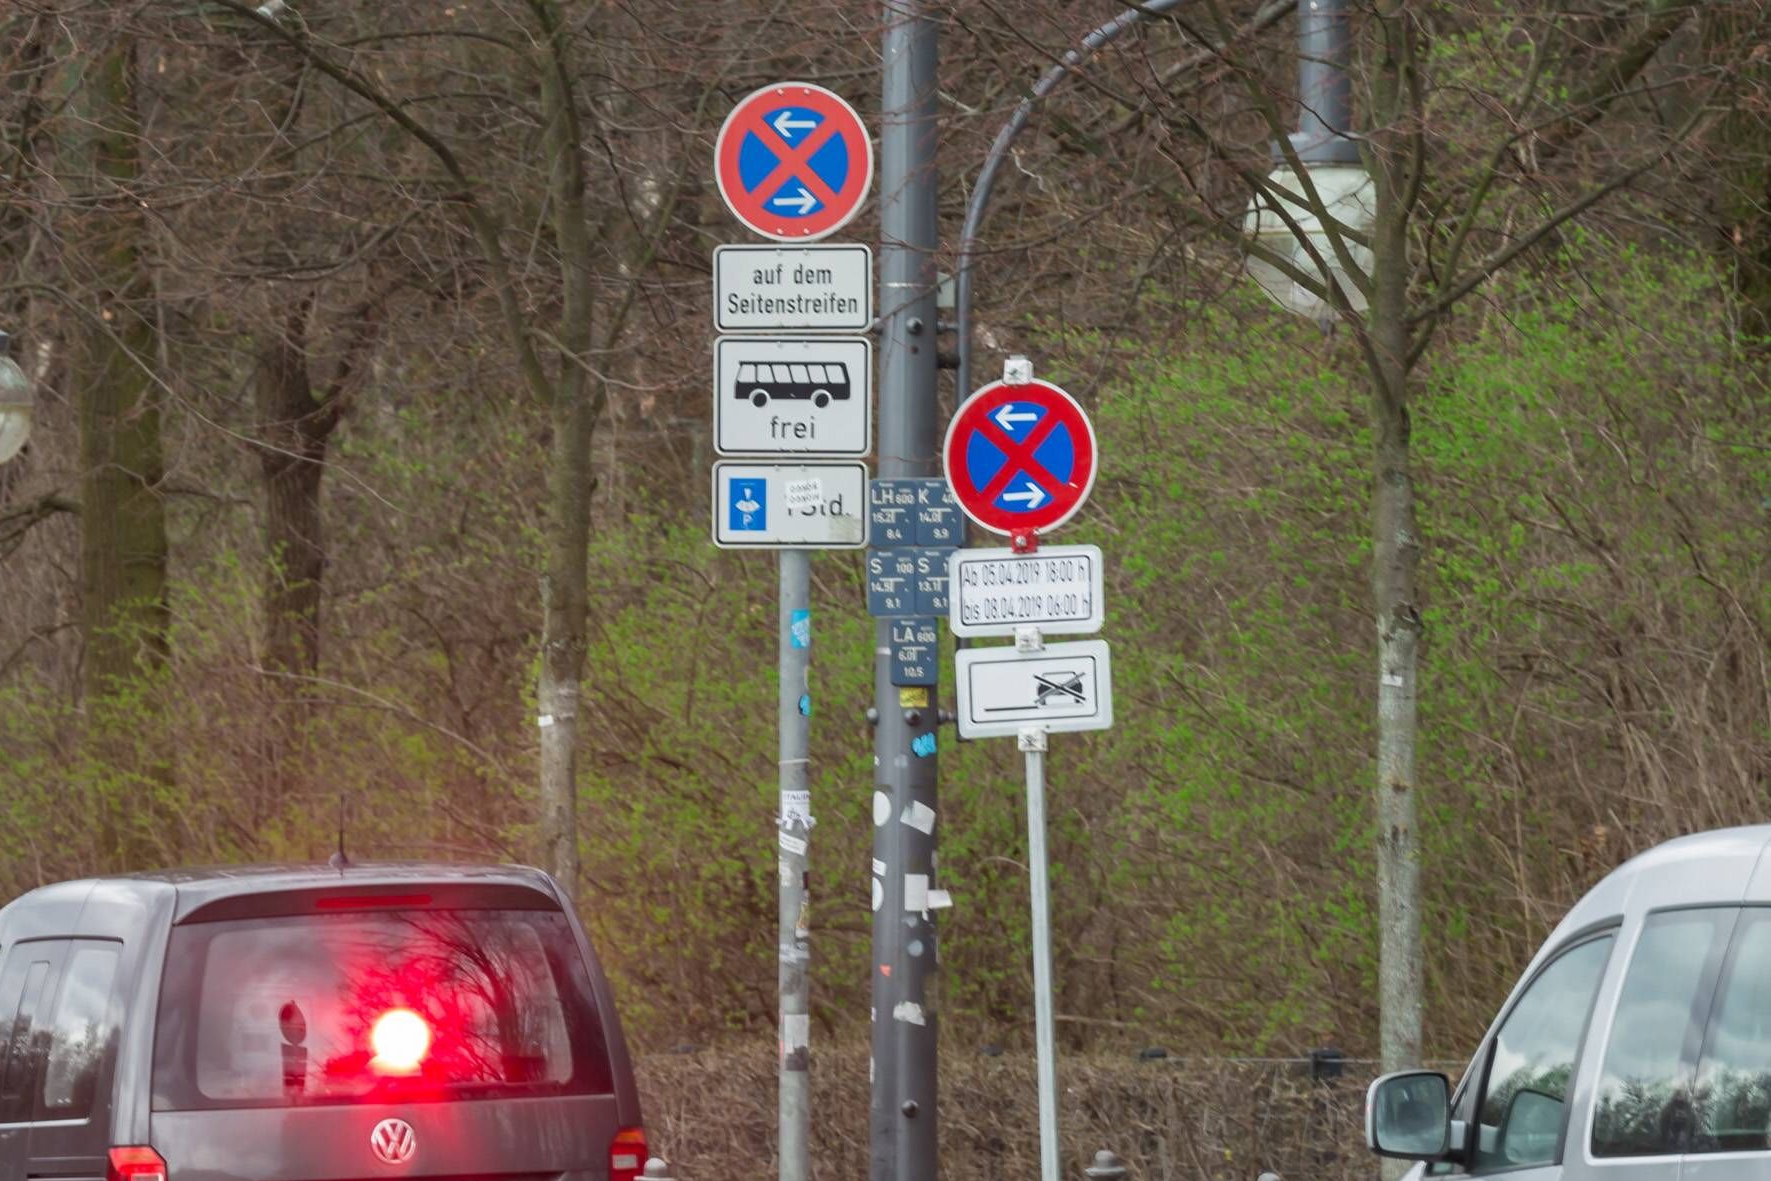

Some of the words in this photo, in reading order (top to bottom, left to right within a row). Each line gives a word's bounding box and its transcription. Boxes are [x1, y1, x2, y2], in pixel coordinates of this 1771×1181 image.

[753, 264, 782, 285] auf
[794, 264, 832, 285] dem
[728, 293, 858, 314] Seitenstreifen
[770, 416, 815, 439] frei
[871, 488, 894, 505] LH
[918, 488, 930, 505] K
[870, 558, 883, 574] S
[917, 557, 930, 574] S
[963, 565, 978, 586] Ab
[982, 562, 1040, 586] 05.04.2019
[1077, 559, 1085, 581] h
[964, 598, 979, 620] bis
[984, 595, 1042, 620] 08.04.2019
[893, 627, 916, 642] LA
